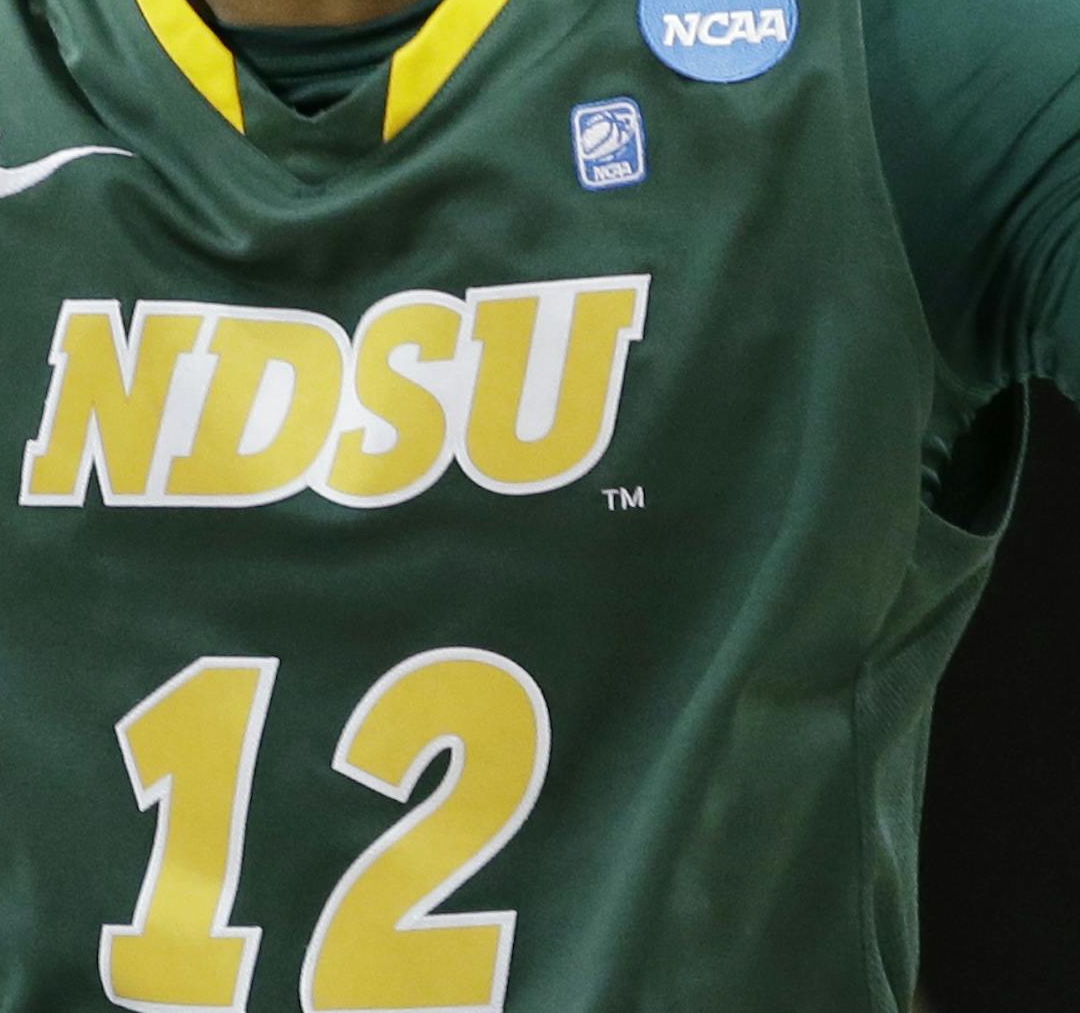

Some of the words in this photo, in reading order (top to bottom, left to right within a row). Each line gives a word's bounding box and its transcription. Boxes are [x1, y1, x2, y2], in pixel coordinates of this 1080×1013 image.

[663, 7, 788, 47] NCAA
[18, 273, 652, 509] NDSU
[602, 485, 646, 512] TM
[98, 646, 552, 1013] 12
